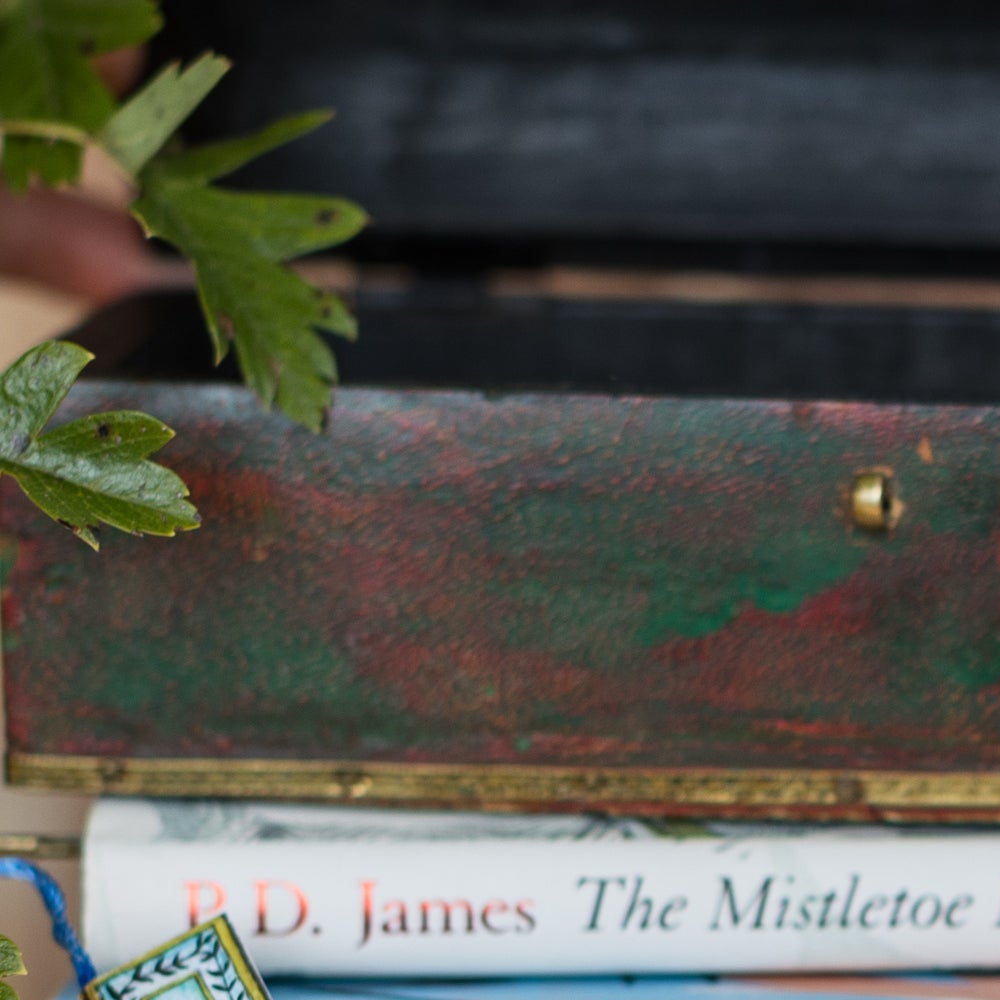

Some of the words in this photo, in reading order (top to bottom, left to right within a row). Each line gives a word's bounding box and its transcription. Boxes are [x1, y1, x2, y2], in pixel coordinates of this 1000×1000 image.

[356, 879, 537, 951] James
[577, 873, 688, 932] The
[708, 872, 974, 932] Mistletoe
